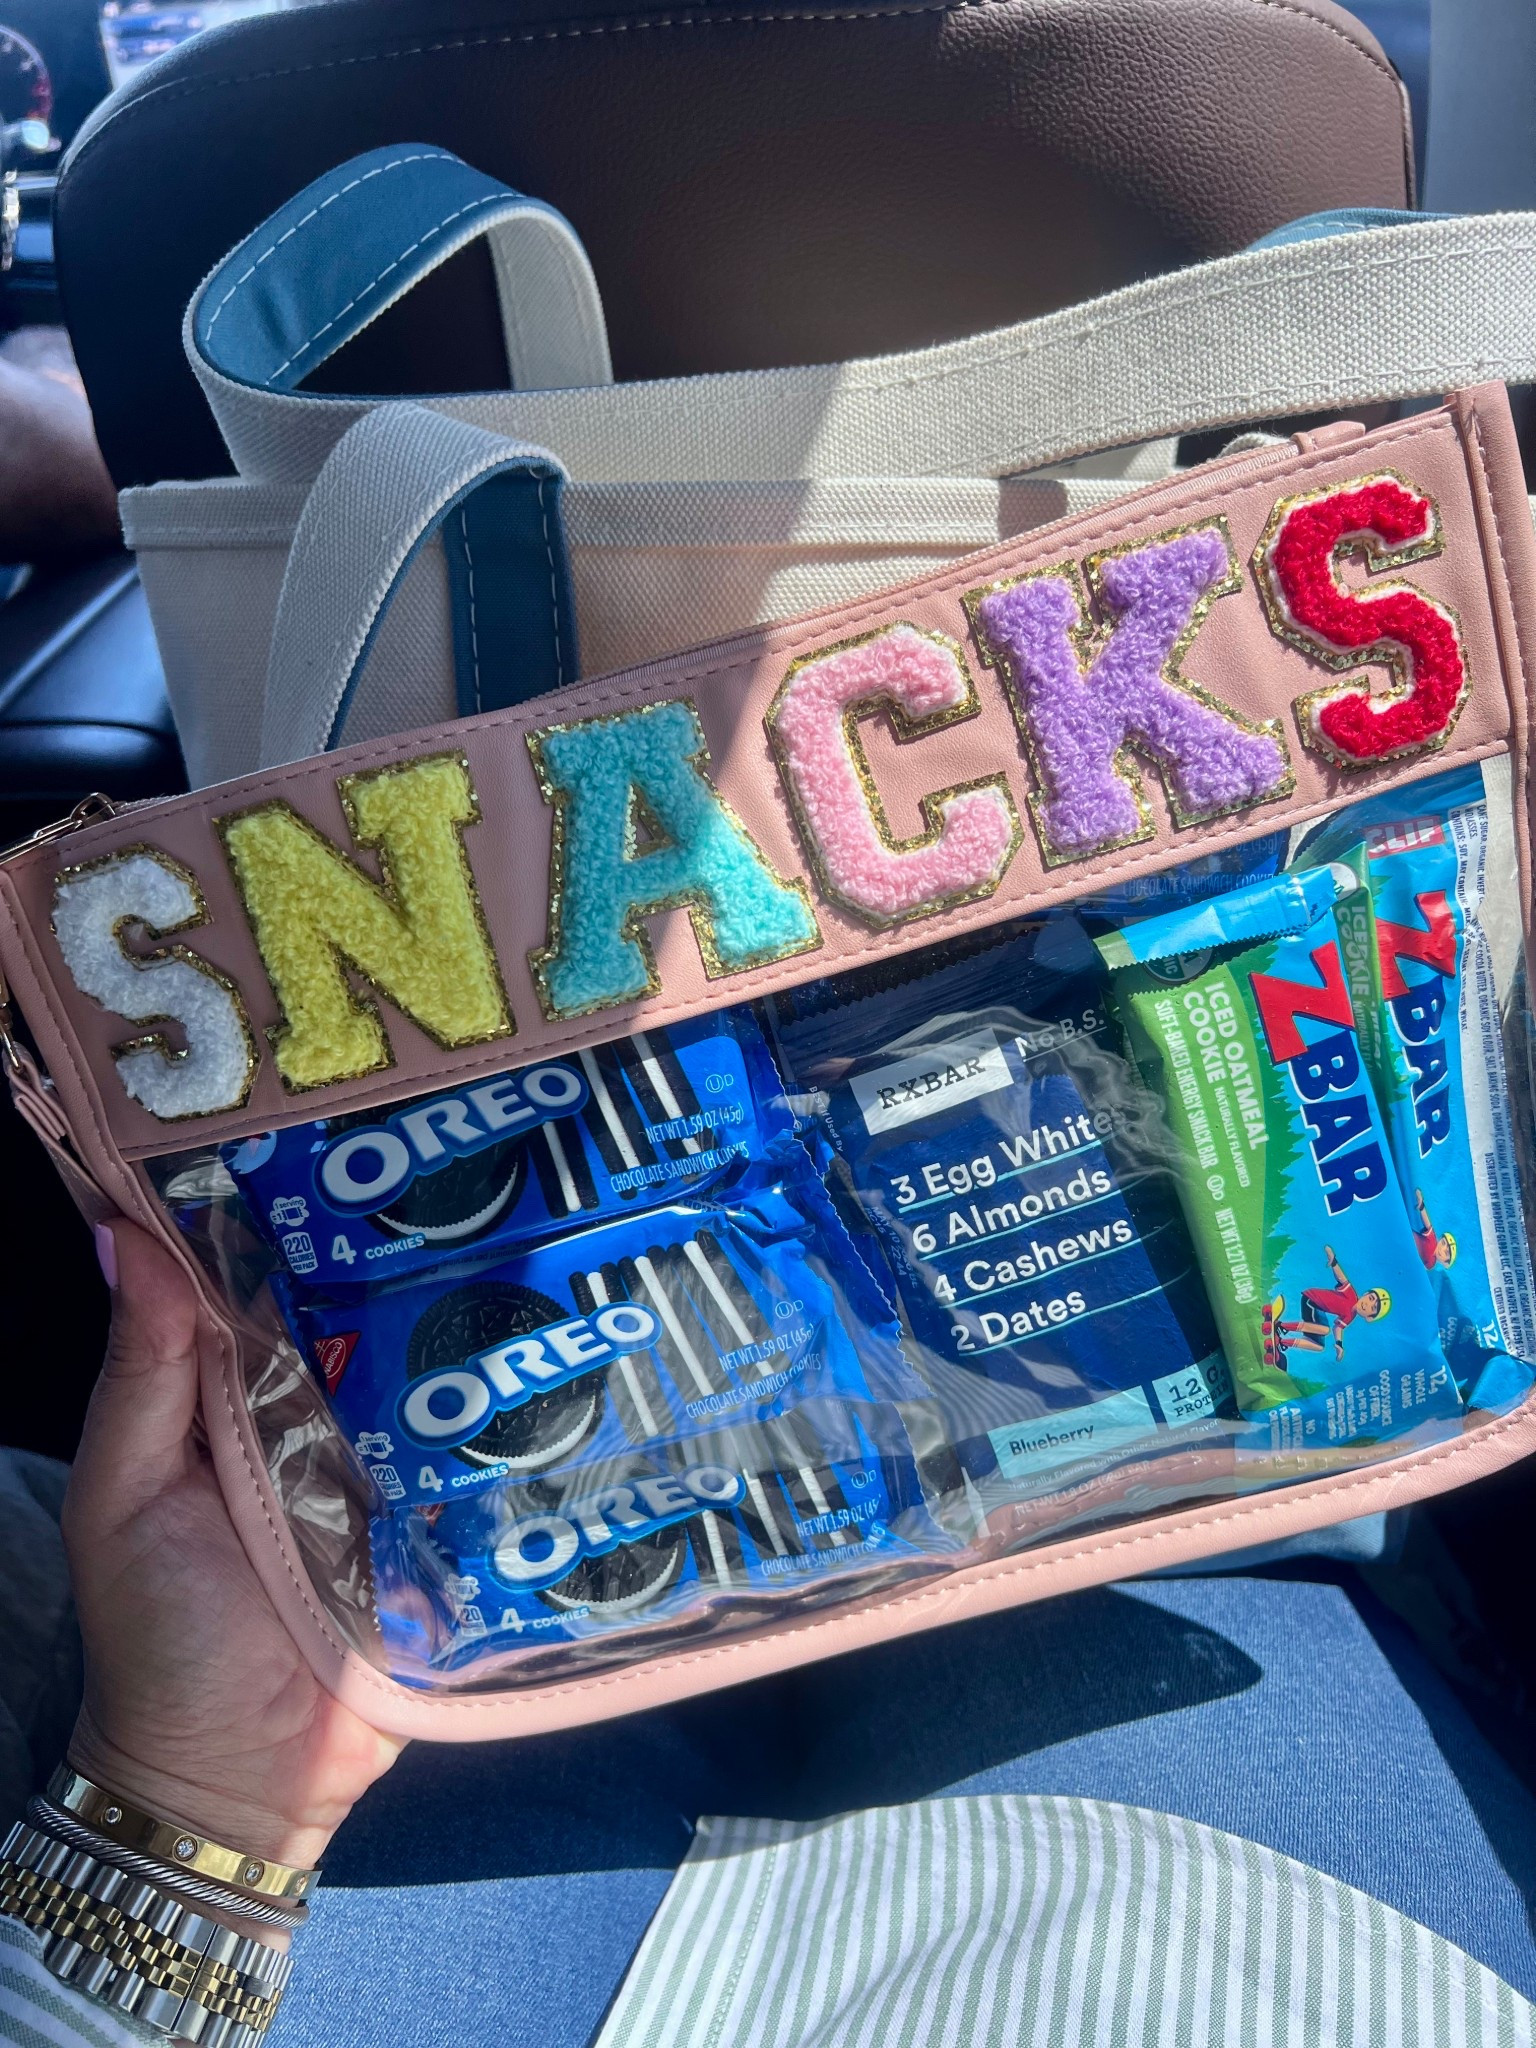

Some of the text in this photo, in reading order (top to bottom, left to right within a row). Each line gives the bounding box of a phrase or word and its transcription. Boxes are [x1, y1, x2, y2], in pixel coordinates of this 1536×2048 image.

[50, 466, 1470, 1123] SNACKS
[1365, 819, 1436, 854] CLIF
[1459, 860, 1468, 875] MAY
[1477, 846, 1487, 873] ORGANIC
[1180, 873, 1233, 894] SANDWICH
[1014, 1008, 1105, 1058] No B.S.
[1154, 999, 1192, 1069] SOFT-BAKED
[876, 1054, 987, 1110] RXBAR
[1204, 981, 1270, 1151] ICED OATMEAL
[1175, 1067, 1202, 1112] ENERGY
[1183, 991, 1251, 1189] COOKIE NATURALLY FLAVORED
[321, 1066, 583, 1203] OREO
[645, 1102, 745, 1145] NET WT 1.59 OZ (45g)
[809, 1085, 824, 1112] BEST
[824, 1117, 840, 1140] Used
[834, 1140, 845, 1153] By
[1187, 1102, 1213, 1144] SNACK
[610, 1163, 666, 1194] CHOCOLATE
[665, 1152, 716, 1180] SANDWICH
[1197, 1141, 1219, 1170] BAR
[890, 1174, 917, 1205] 3
[921, 1155, 997, 1195] Egg
[912, 1224, 937, 1253] 6
[948, 1168, 1111, 1245] Almonds
[1214, 1207, 1236, 1228] NET
[284, 1235, 311, 1255] 220
[331, 1233, 426, 1265] 4 COOKIES
[1219, 1224, 1240, 1241] WT
[933, 1274, 957, 1301] 4
[963, 1219, 1133, 1291] Cashews
[1230, 1262, 1250, 1279] OZ
[1233, 1276, 1259, 1305] (36g)
[950, 1290, 1087, 1351] 2 Dates
[1482, 1319, 1499, 1349] 12
[717, 1353, 741, 1373] NET
[739, 1348, 757, 1366] WT
[756, 1341, 777, 1362] 1.59
[776, 1334, 791, 1354] OZ
[403, 1305, 656, 1439] OREO
[1378, 1368, 1391, 1400] GOOD
[1414, 1368, 1426, 1405] WHOLE
[685, 1392, 740, 1419] CHOCOLATE
[739, 1371, 789, 1404] SANDWICH
[1167, 1377, 1203, 1403] 12
[1173, 1383, 1230, 1418] PROTEIN
[1400, 1373, 1413, 1409] GRAINS
[1008, 1425, 1094, 1457] Blueberry
[1305, 1418, 1316, 1435] NO
[373, 1466, 397, 1483] 220
[417, 1463, 509, 1493] 4 COOKIES
[493, 1466, 739, 1581] OREO
[795, 1519, 814, 1538] NET
[813, 1516, 830, 1534] WT
[830, 1512, 850, 1533] 1.59
[849, 1507, 865, 1527] OZ
[761, 1543, 860, 1577] CHOCOLATE SANDWICH
[499, 1607, 526, 1633] 4
[532, 1606, 590, 1630] COOKIES
